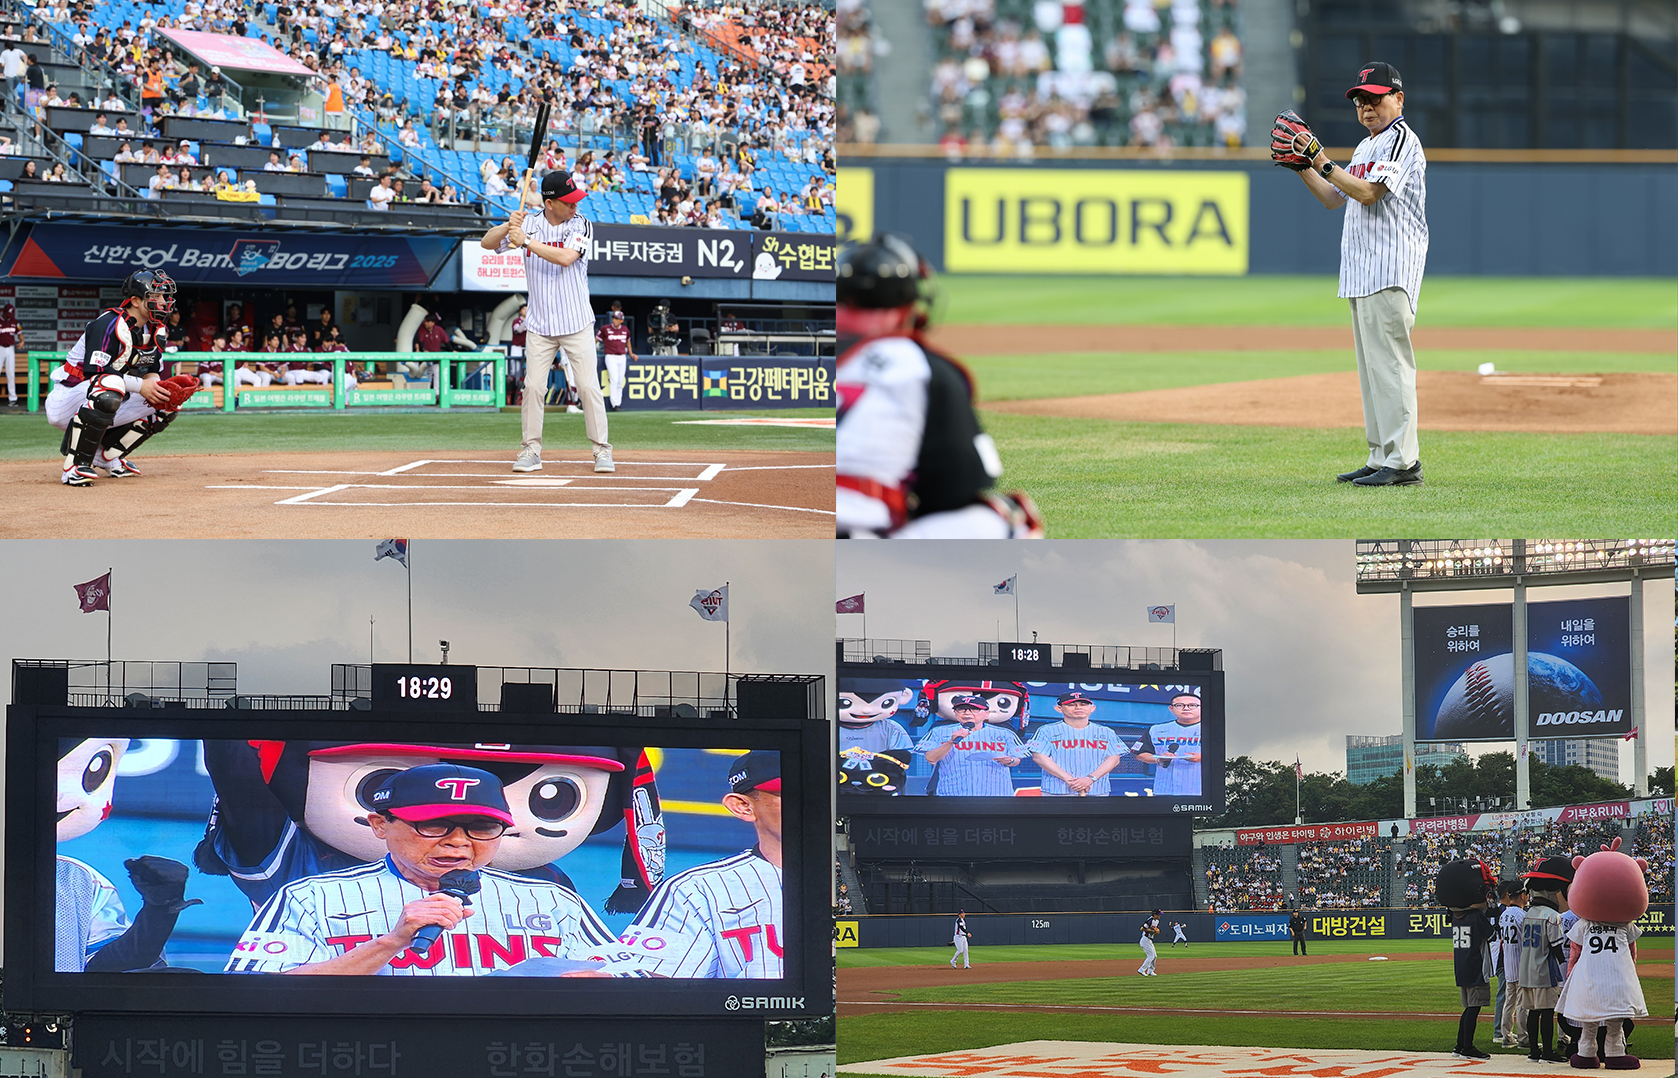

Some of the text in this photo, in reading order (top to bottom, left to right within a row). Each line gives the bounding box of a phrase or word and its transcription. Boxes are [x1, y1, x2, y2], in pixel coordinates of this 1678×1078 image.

[1359, 68, 1375, 83] T
[961, 194, 1236, 246] UBORA
[762, 236, 779, 252] Sh
[84, 245, 131, 264] 신한
[130, 244, 180, 268] SOL
[179, 248, 234, 268] Ban
[350, 254, 399, 268] 2025
[482, 254, 504, 265] 승리를
[698, 238, 744, 273] N2,
[777, 243, 836, 271] 수협보
[477, 267, 526, 278] 하나의 트윈스
[628, 365, 698, 400] 금강주택
[728, 367, 830, 401] 금강펜테리움
[1446, 624, 1480, 638] 승리를
[1560, 618, 1596, 632] 내일을
[1446, 639, 1480, 652] 위하여
[1560, 633, 1596, 647] 위하여
[1010, 647, 1040, 662] 18:28
[397, 676, 452, 700] 18:29
[1536, 709, 1623, 726] DOOSAN
[942, 741, 1007, 752] WINS
[1051, 739, 1108, 750] TWINS
[435, 777, 480, 800] T
[1180, 804, 1213, 812] SAMIK
[1567, 804, 1624, 821] 기부&RUN
[1334, 825, 1376, 836] 하이리빙
[1415, 816, 1468, 833] 달려라병원
[865, 827, 1017, 845] 시작에 힘을 더하다
[1056, 827, 1165, 845] 한화손해보험
[1240, 828, 1315, 842] 야구와 인생은 타이밍
[506, 913, 552, 931] LG
[1031, 919, 1050, 929] 125m
[1229, 923, 1289, 936] 도미노피자
[1312, 915, 1386, 937] 대방건설
[1452, 926, 1472, 949] 25
[1523, 923, 1541, 948] 25
[1589, 936, 1619, 954] 94
[741, 996, 806, 1010] SAMIK
[100, 1037, 402, 1077] 시작에 힘을 더하다
[485, 1041, 707, 1078] 한화손해보험
